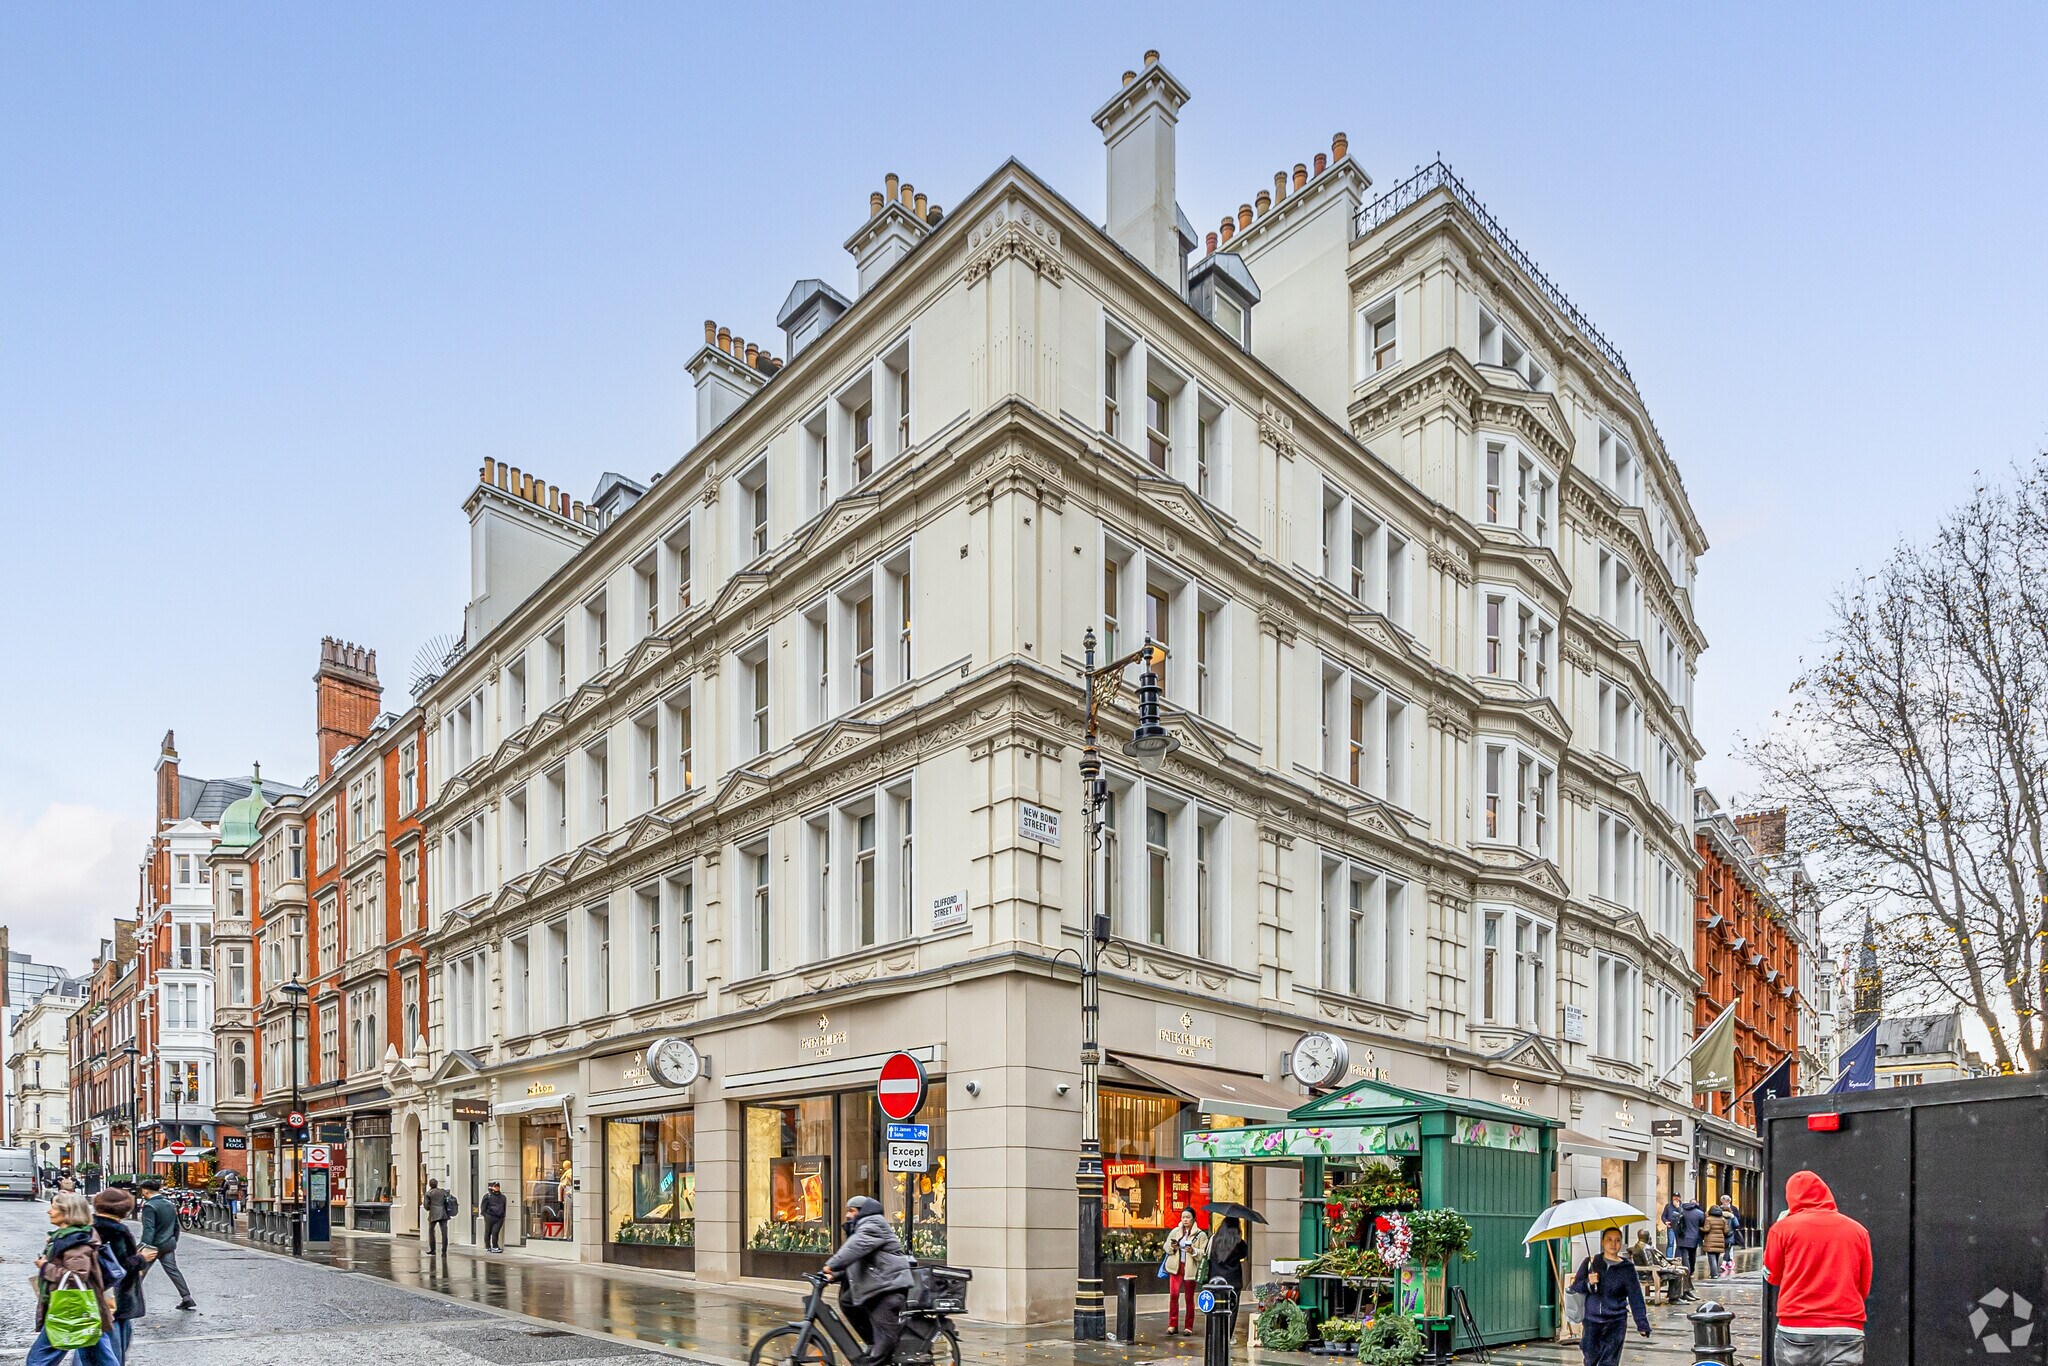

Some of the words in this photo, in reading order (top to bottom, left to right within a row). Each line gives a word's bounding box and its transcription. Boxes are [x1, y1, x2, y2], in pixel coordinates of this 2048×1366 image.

[1023, 806, 1038, 819] NEW
[1040, 812, 1057, 826] BOND
[1023, 817, 1046, 832] STREET
[1048, 825, 1057, 835] W1
[934, 895, 958, 909] CLIFFORD
[934, 906, 952, 919] STREET
[955, 903, 963, 912] W1
[1159, 1029, 1183, 1044] PATEK
[1182, 1033, 1213, 1049] PHILIPPE
[892, 1147, 925, 1157] Except
[893, 1158, 922, 1168] cycles
[1108, 1164, 1145, 1175] EXHIBITION
[1172, 1173, 1181, 1182] THE
[1172, 1183, 1188, 1191] FUTURE
[1172, 1192, 1178, 1200] IS
